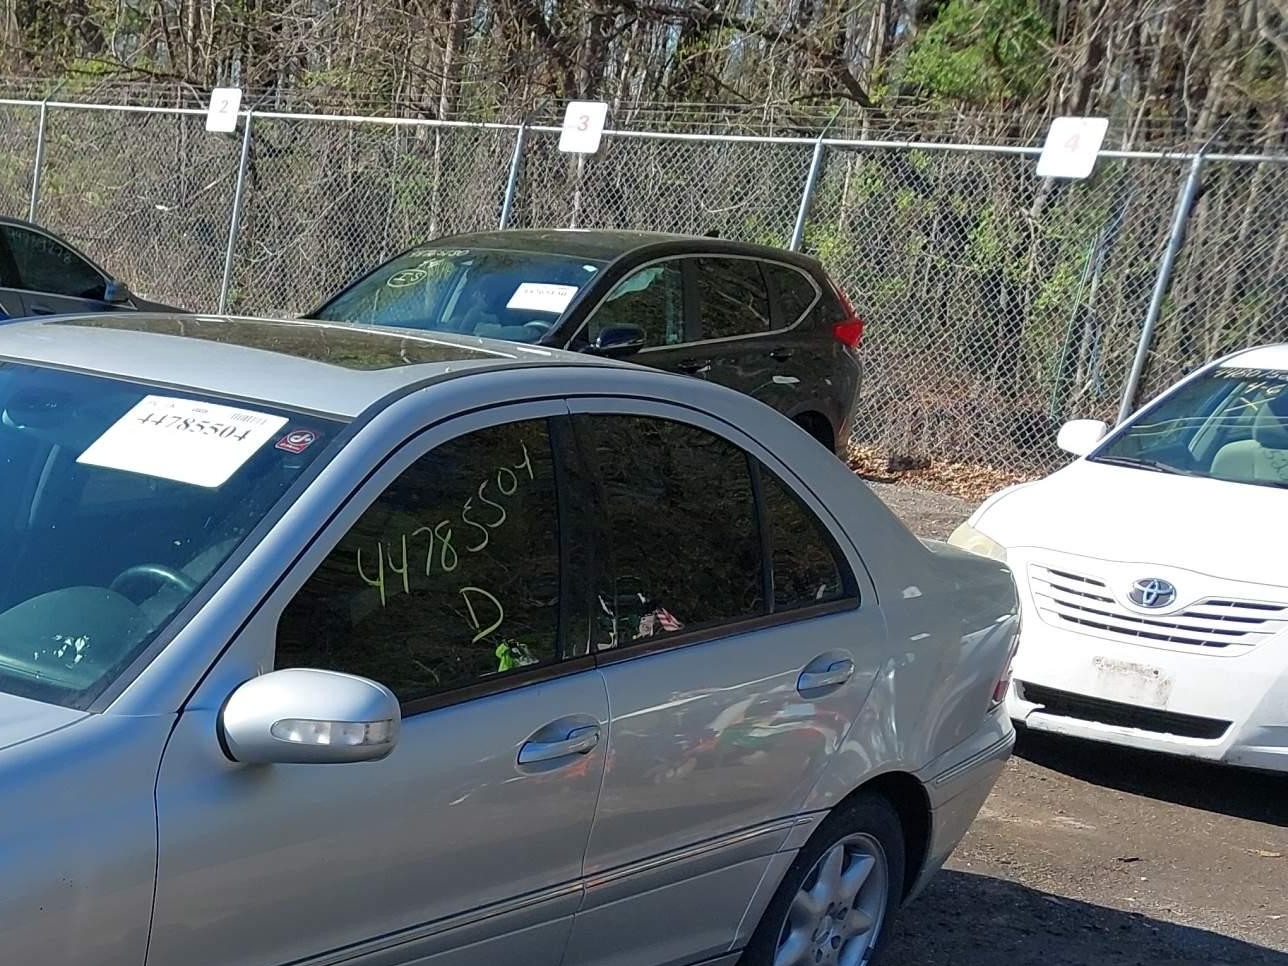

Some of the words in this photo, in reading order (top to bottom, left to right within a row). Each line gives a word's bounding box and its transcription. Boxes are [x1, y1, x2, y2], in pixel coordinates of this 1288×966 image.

[219, 99, 230, 114] 2
[577, 114, 591, 132] 3
[1063, 133, 1081, 152] 4
[137, 412, 252, 441] 44785504
[357, 439, 534, 609] 44785504
[459, 586, 504, 643] D
